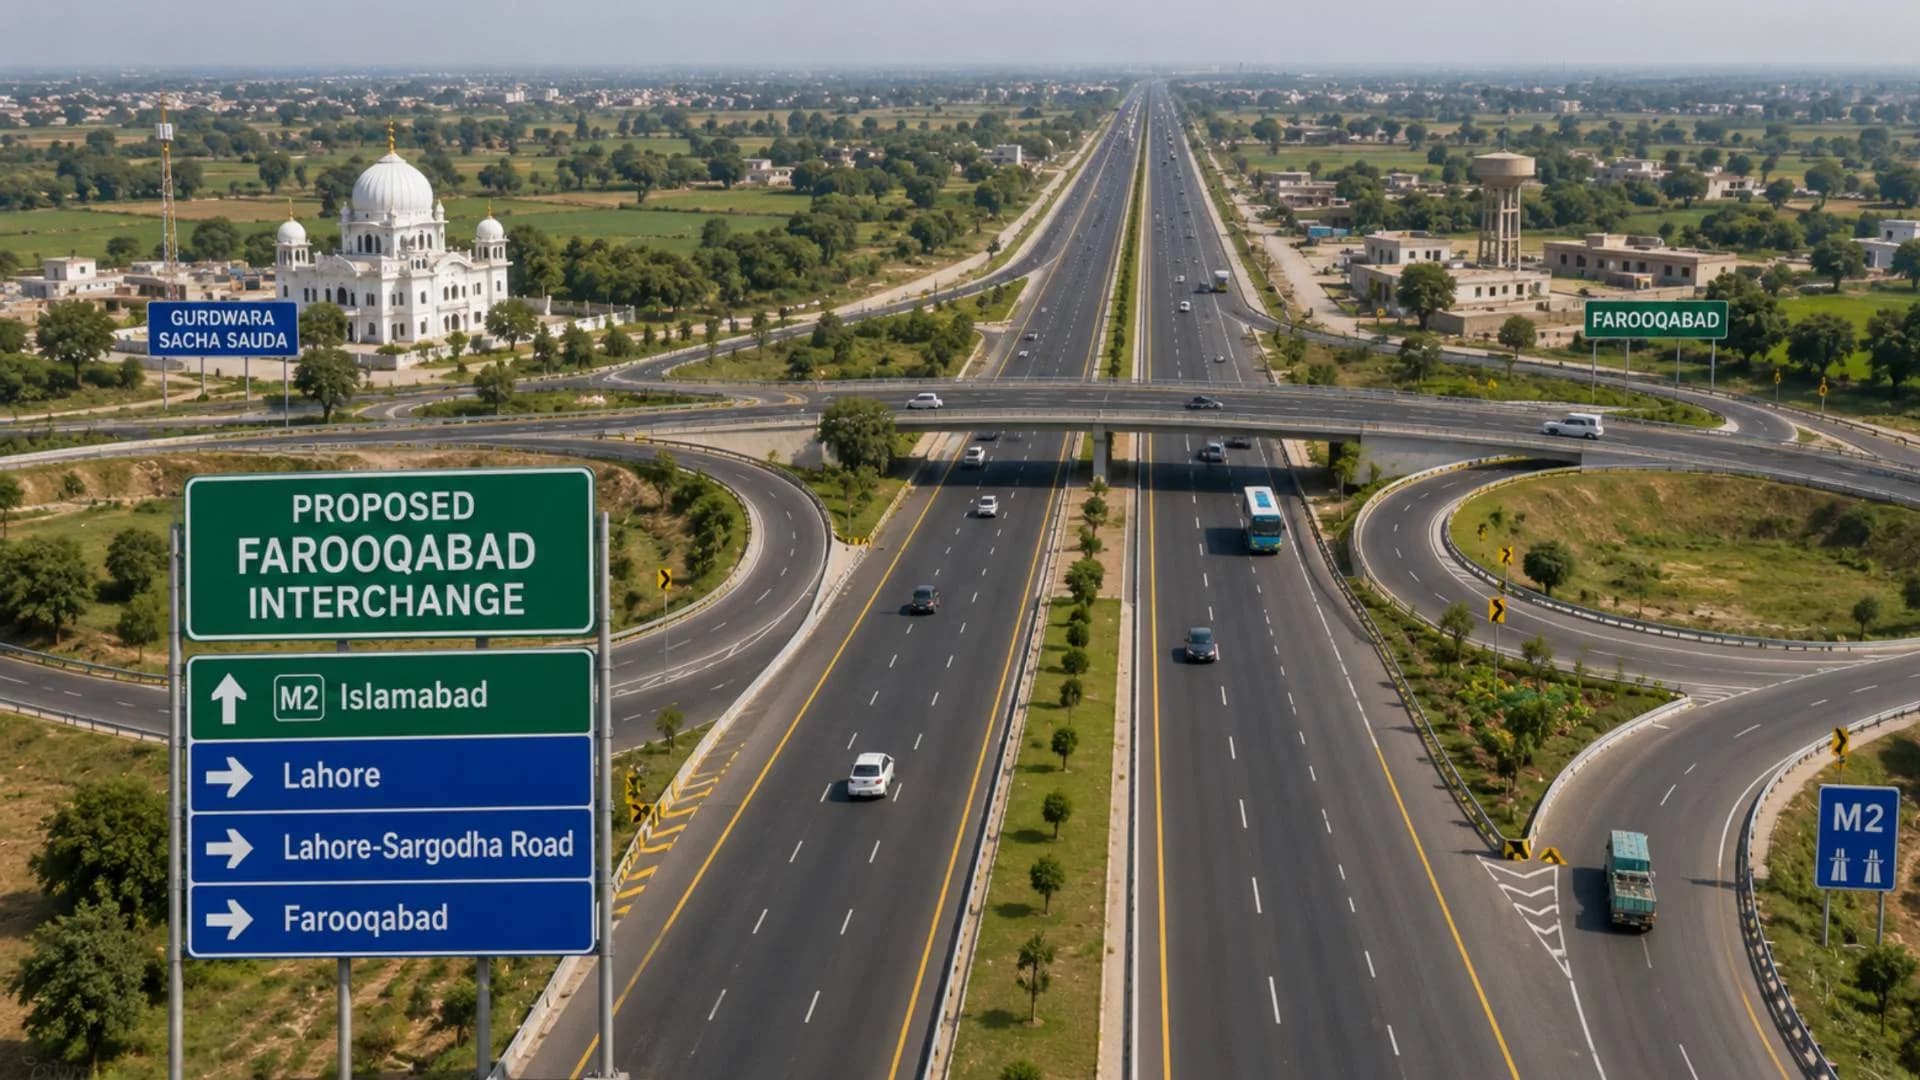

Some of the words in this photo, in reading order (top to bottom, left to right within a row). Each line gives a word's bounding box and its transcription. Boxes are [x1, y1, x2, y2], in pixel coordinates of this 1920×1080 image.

[170, 309, 275, 326] GURDWARA
[1592, 311, 1720, 332] FAROOQABAD
[159, 332, 221, 350] SACHA
[226, 332, 288, 350] SAUDA
[293, 491, 475, 523] PROPOSED
[238, 532, 536, 575] FAROOQABAD
[249, 583, 525, 619] INTERCHANGE
[280, 685, 319, 711] M2
[341, 680, 488, 710] Islamabad
[284, 761, 381, 789] Lahore
[1833, 803, 1884, 833] M2
[284, 832, 503, 865] Lahore-Sargodha
[511, 830, 574, 858] Road
[284, 904, 448, 938] Farooqabad
